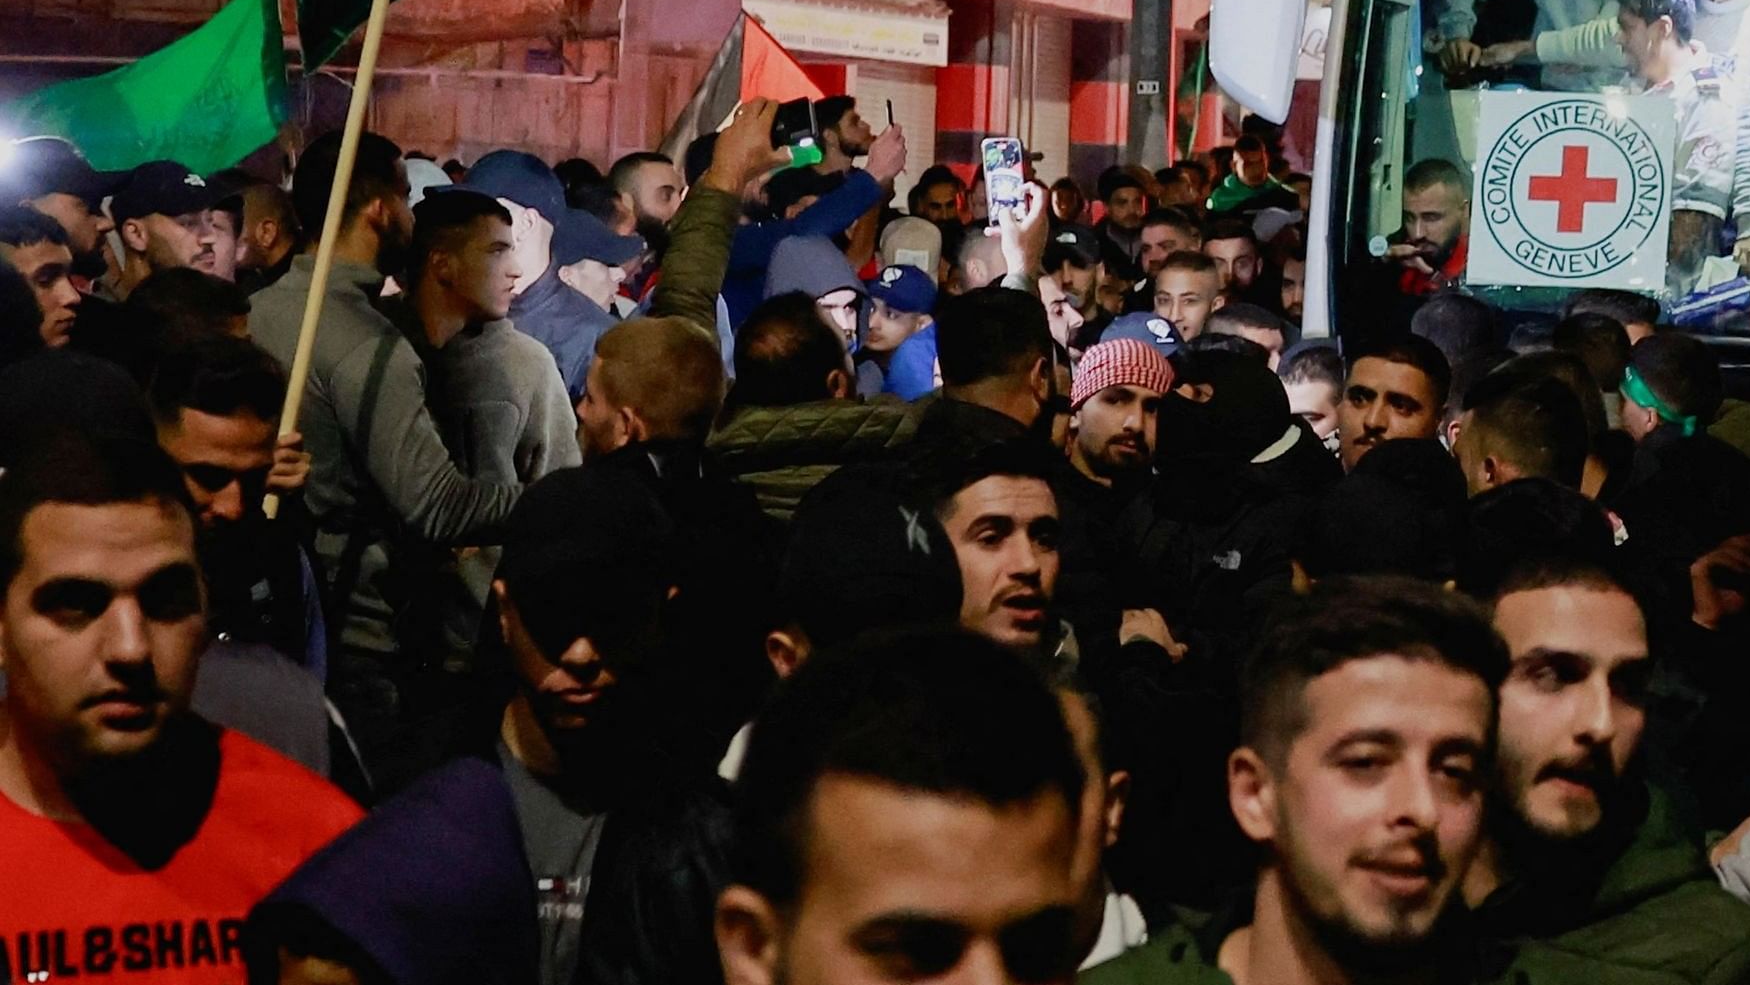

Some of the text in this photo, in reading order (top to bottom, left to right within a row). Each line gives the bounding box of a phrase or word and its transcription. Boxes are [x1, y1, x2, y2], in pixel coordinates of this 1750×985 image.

[1487, 105, 1658, 231] COMITE INTERNATIONAL
[1514, 239, 1620, 273] GENEVE
